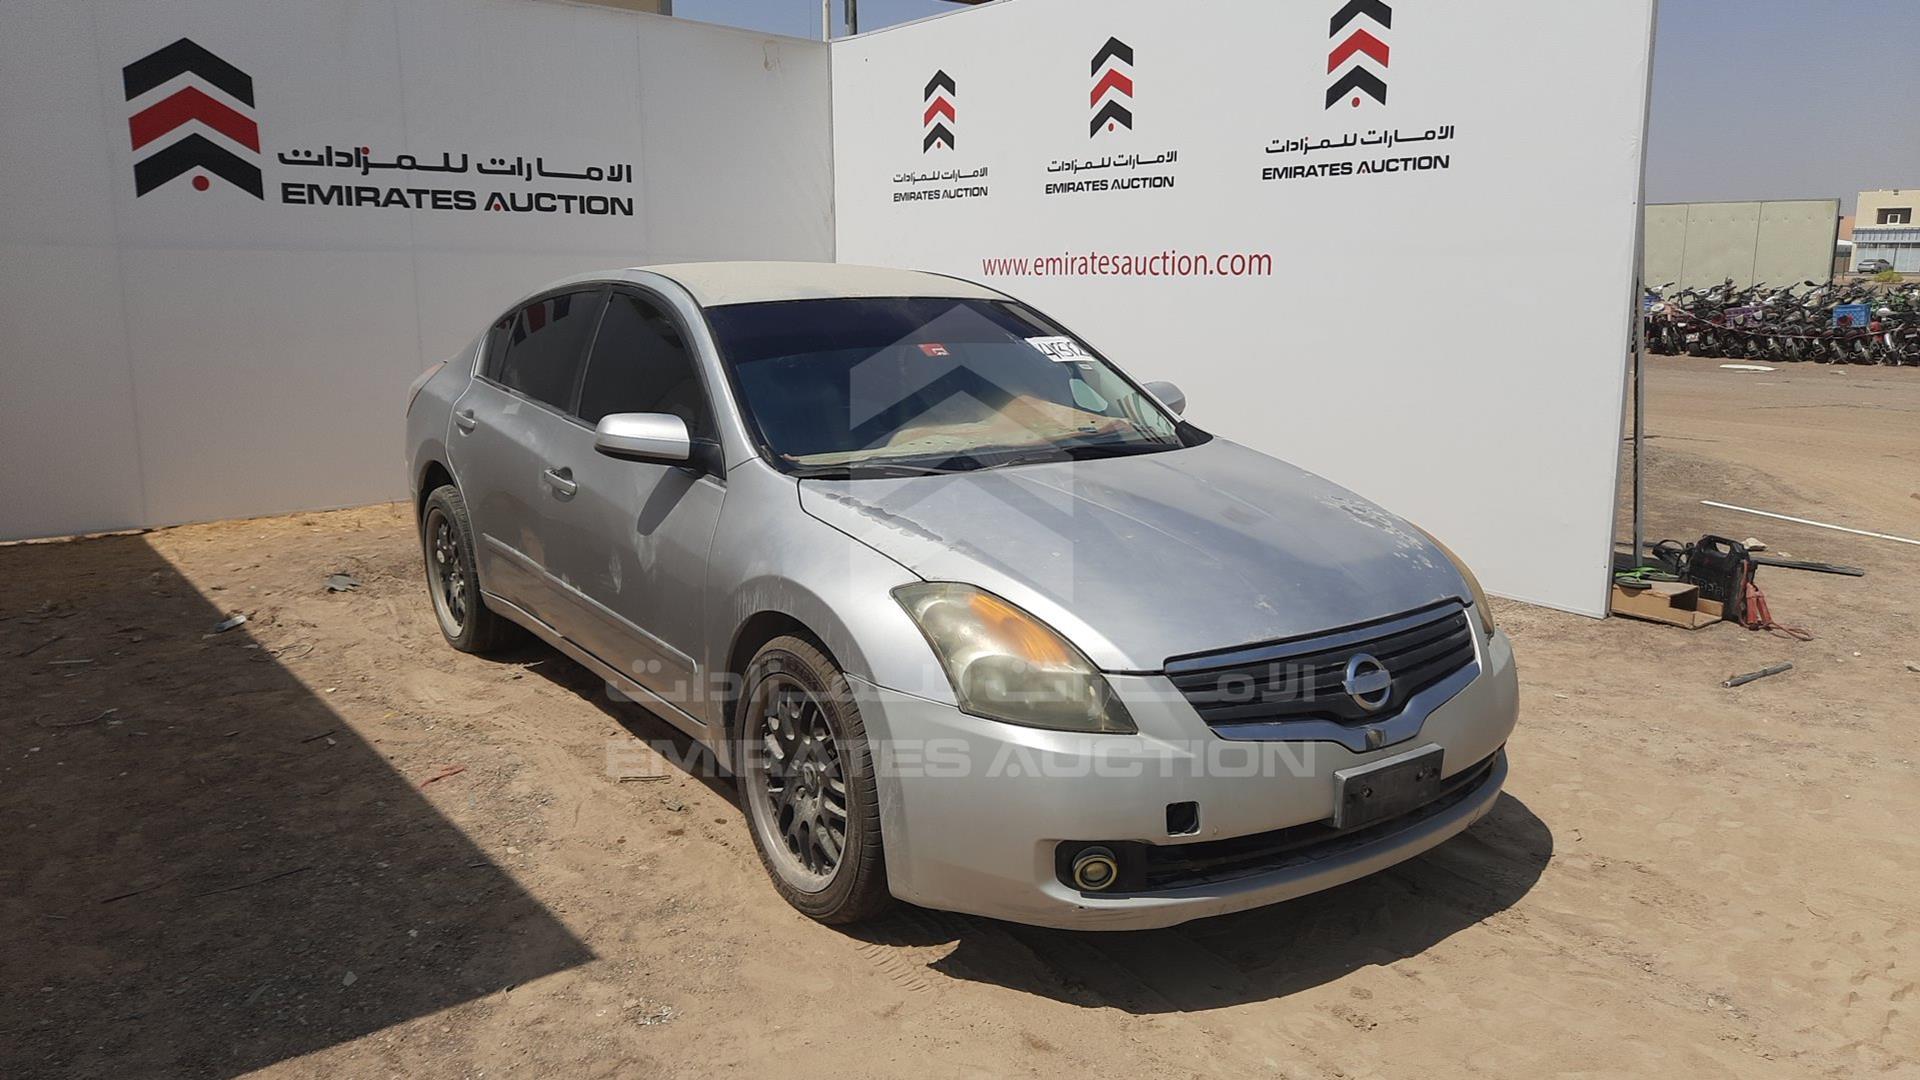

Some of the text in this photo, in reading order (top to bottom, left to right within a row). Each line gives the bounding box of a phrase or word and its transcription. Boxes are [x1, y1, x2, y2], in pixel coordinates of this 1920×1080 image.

[1261, 154, 1450, 180] EMIRATES AUCTION
[893, 186, 988, 202] EMIRATES AUCTION
[1045, 176, 1175, 194] EMIRATES AUCTION
[281, 182, 634, 216] EMIRATES AUCTION
[982, 250, 1272, 276] www.emiratesauction.com
